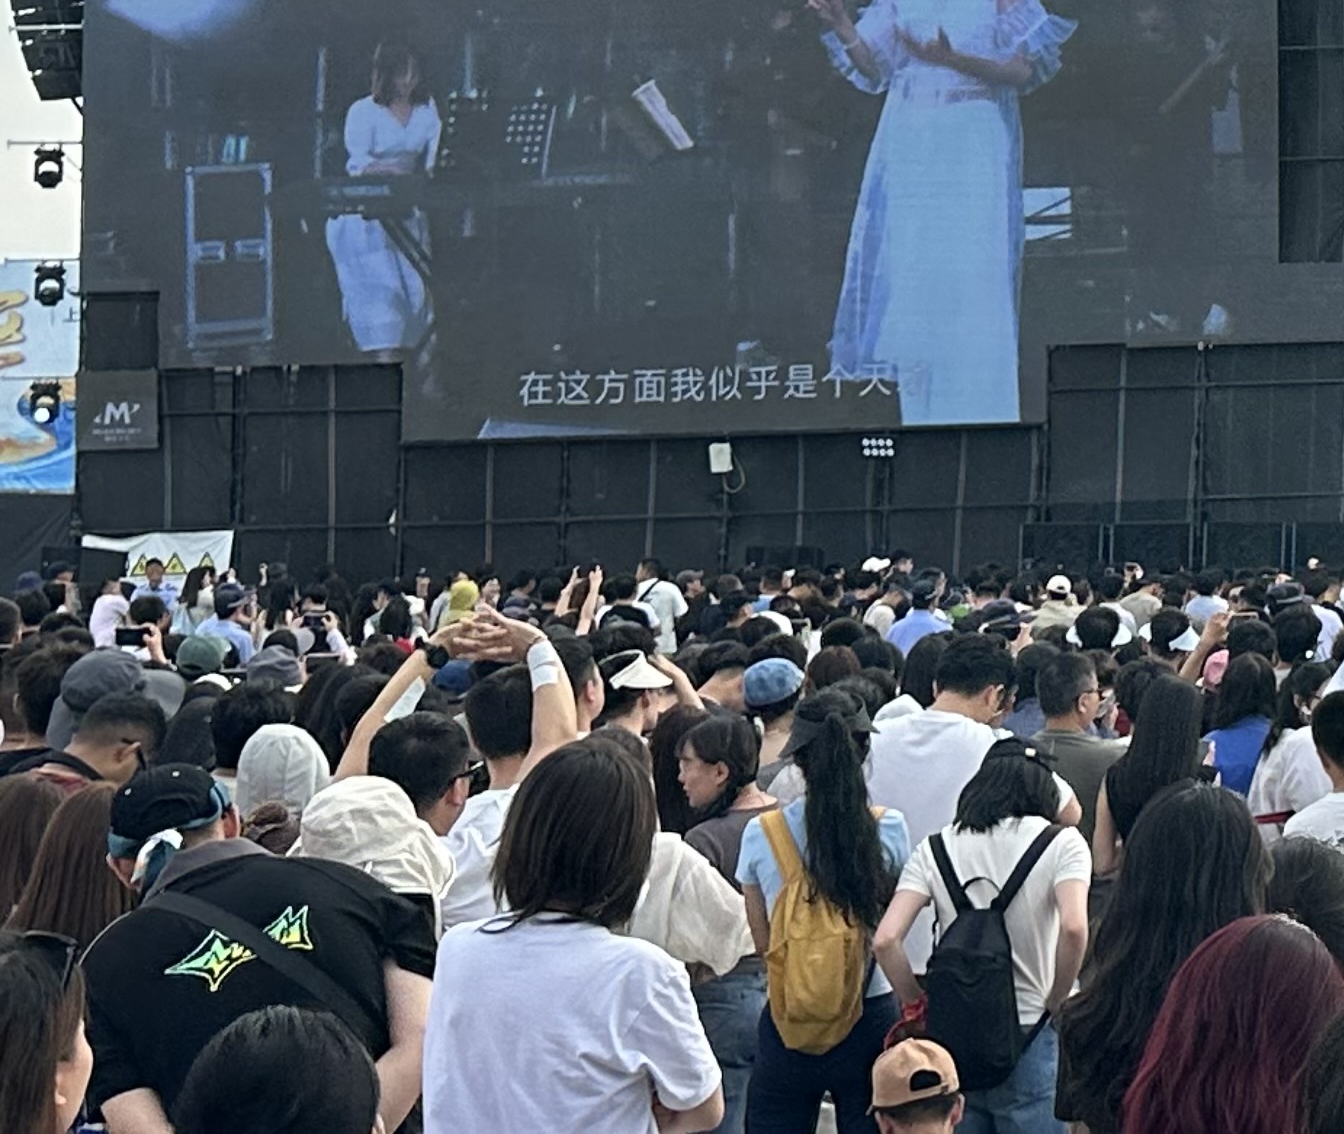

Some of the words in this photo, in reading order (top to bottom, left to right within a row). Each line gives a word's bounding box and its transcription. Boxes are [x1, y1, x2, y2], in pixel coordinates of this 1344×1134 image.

[519, 364, 904, 407] 在这方面我似乎是个天
